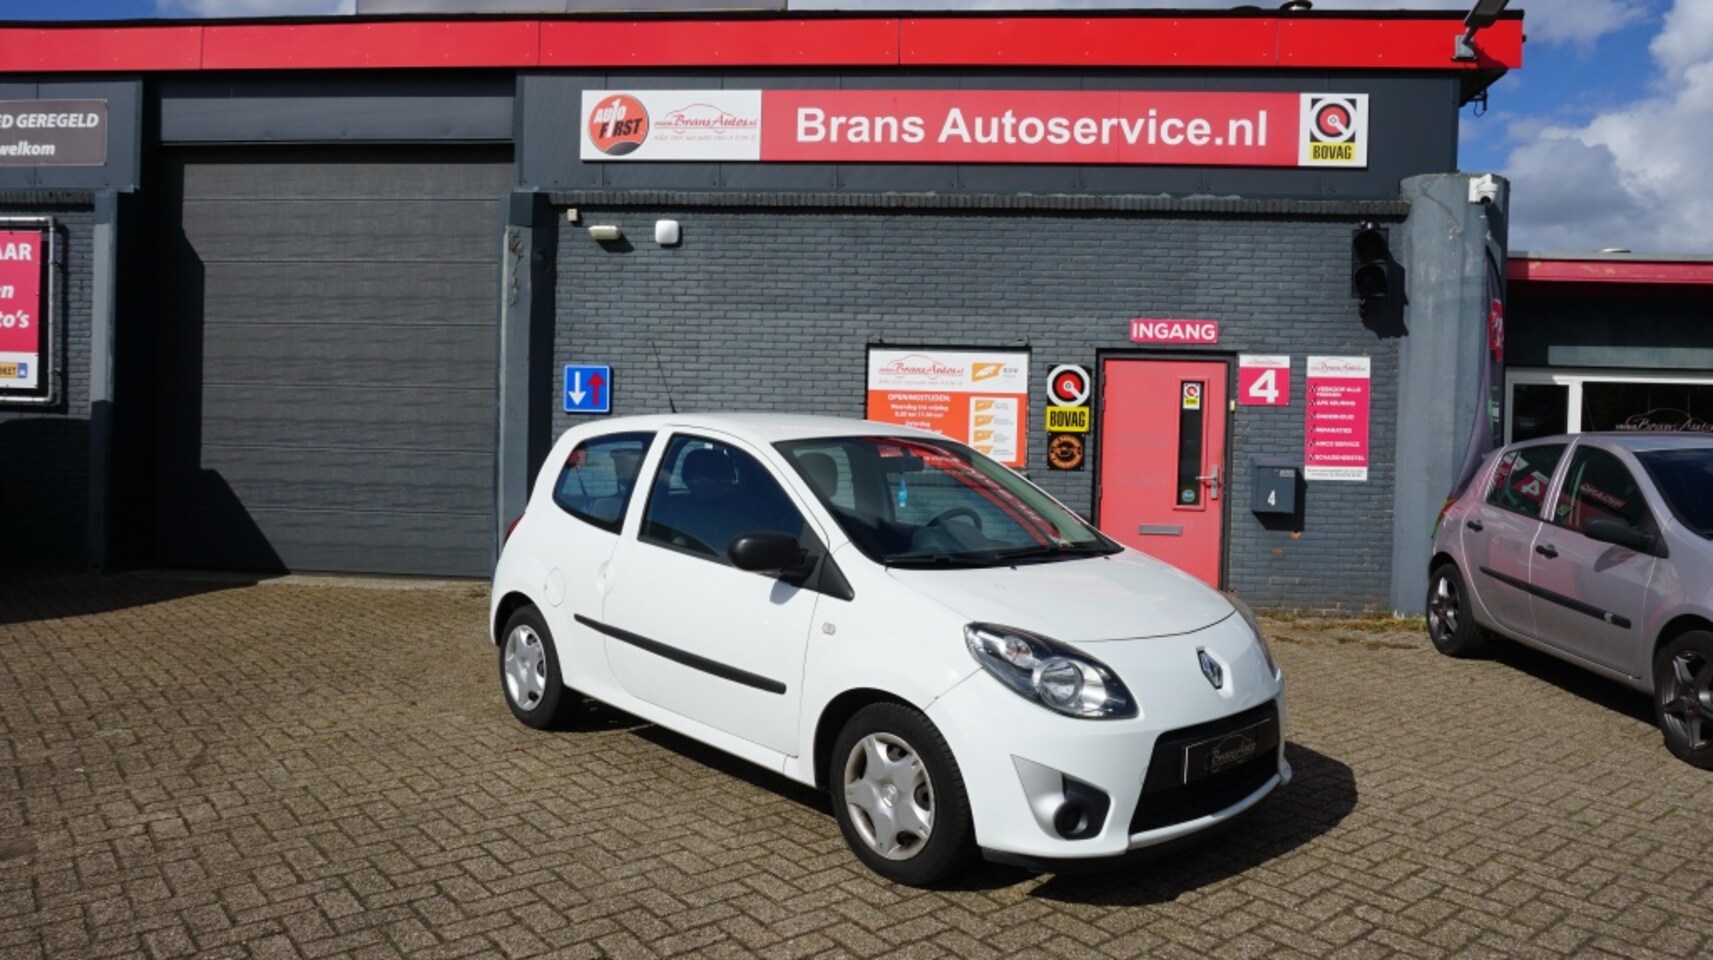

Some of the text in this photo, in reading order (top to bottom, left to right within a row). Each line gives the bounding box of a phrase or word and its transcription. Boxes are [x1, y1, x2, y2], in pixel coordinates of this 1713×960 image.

[16, 113, 99, 129] GEREGELD
[796, 107, 1268, 147] Brans Autoservice.nl
[0, 140, 55, 156] welkom
[1312, 145, 1352, 160] BOVAG
[0, 242, 32, 260] AR
[1132, 322, 1216, 340] INGANG
[1248, 369, 1279, 404] 4
[1049, 410, 1086, 427] BOVAG
[1267, 490, 1276, 506] 4
